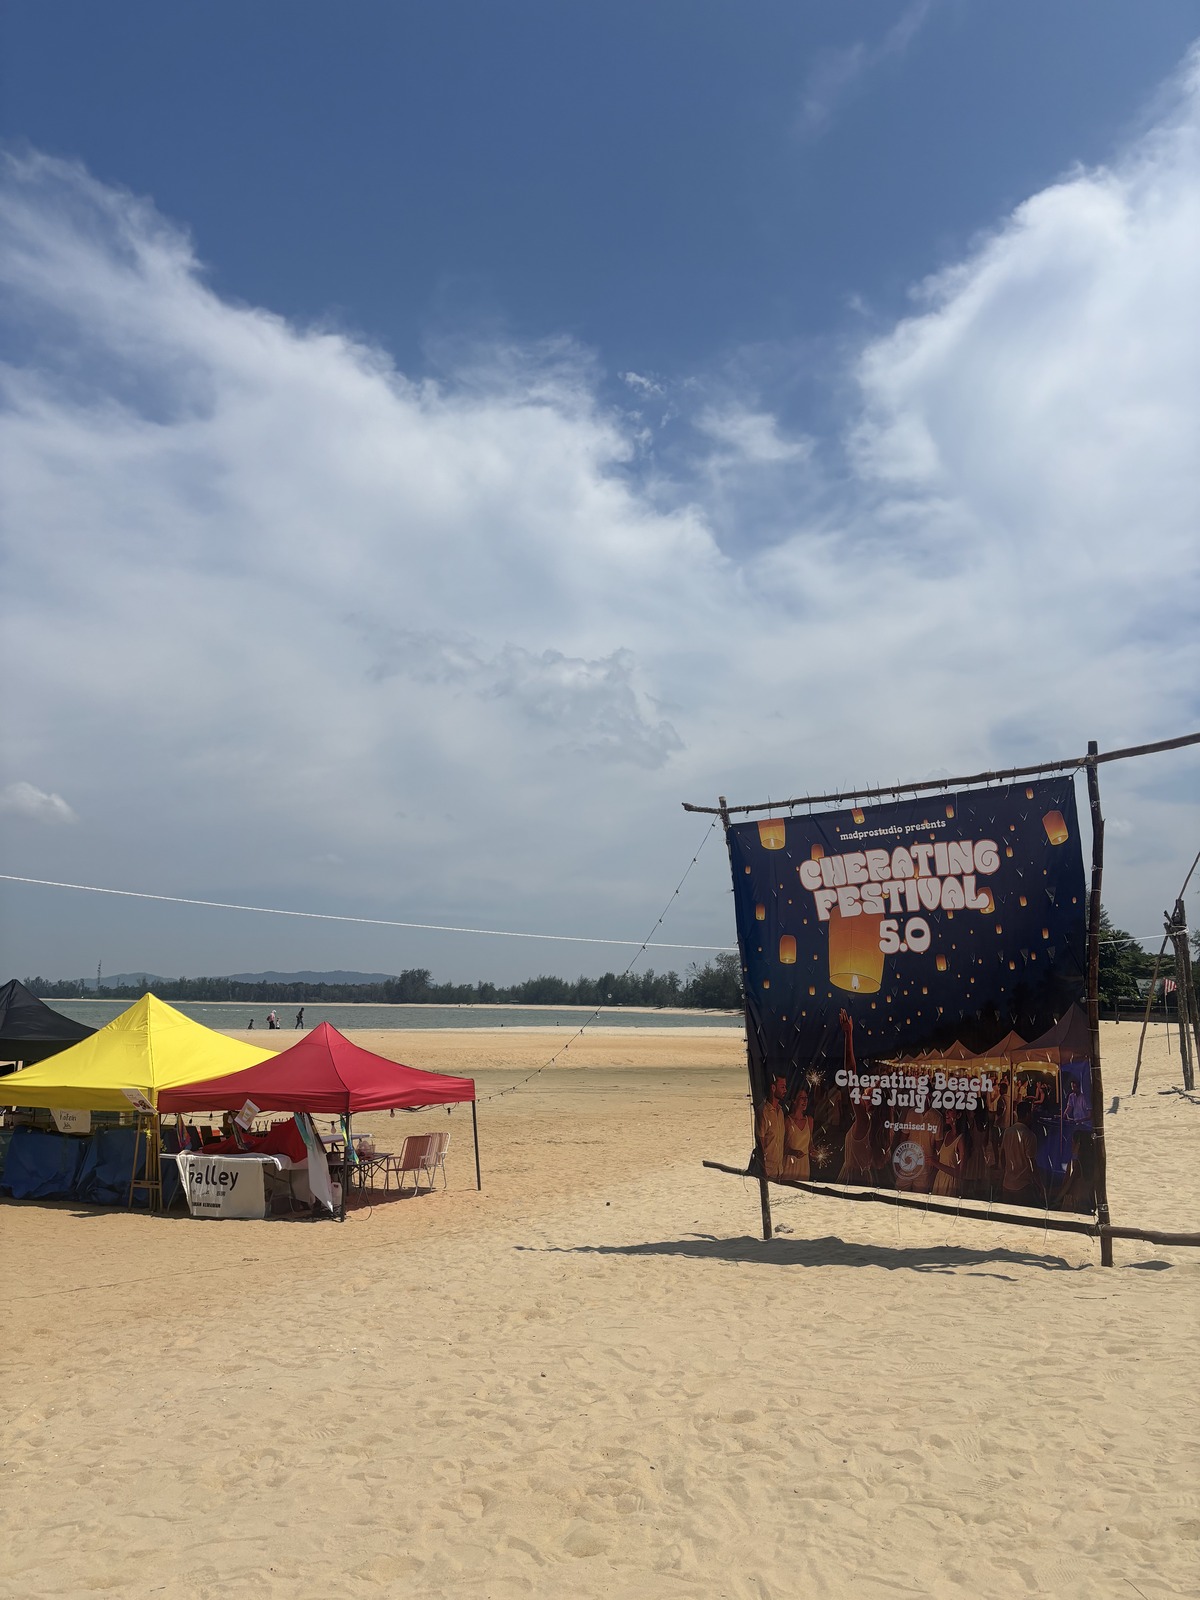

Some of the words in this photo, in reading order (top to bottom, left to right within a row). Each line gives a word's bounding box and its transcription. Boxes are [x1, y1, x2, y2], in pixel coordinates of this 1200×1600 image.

[840, 824, 903, 841] madprostudio
[905, 819, 946, 836] presents
[799, 838, 1001, 891] CHERATING
[813, 874, 990, 922] FESTIVAL
[878, 916, 931, 955] 5.0
[835, 1069, 930, 1095] Cherating
[935, 1073, 993, 1093] Beach
[849, 1088, 883, 1106] 4-5
[886, 1089, 928, 1113] July
[932, 1090, 978, 1111] 2025
[884, 1120, 925, 1132] Organised
[927, 1122, 938, 1134] by
